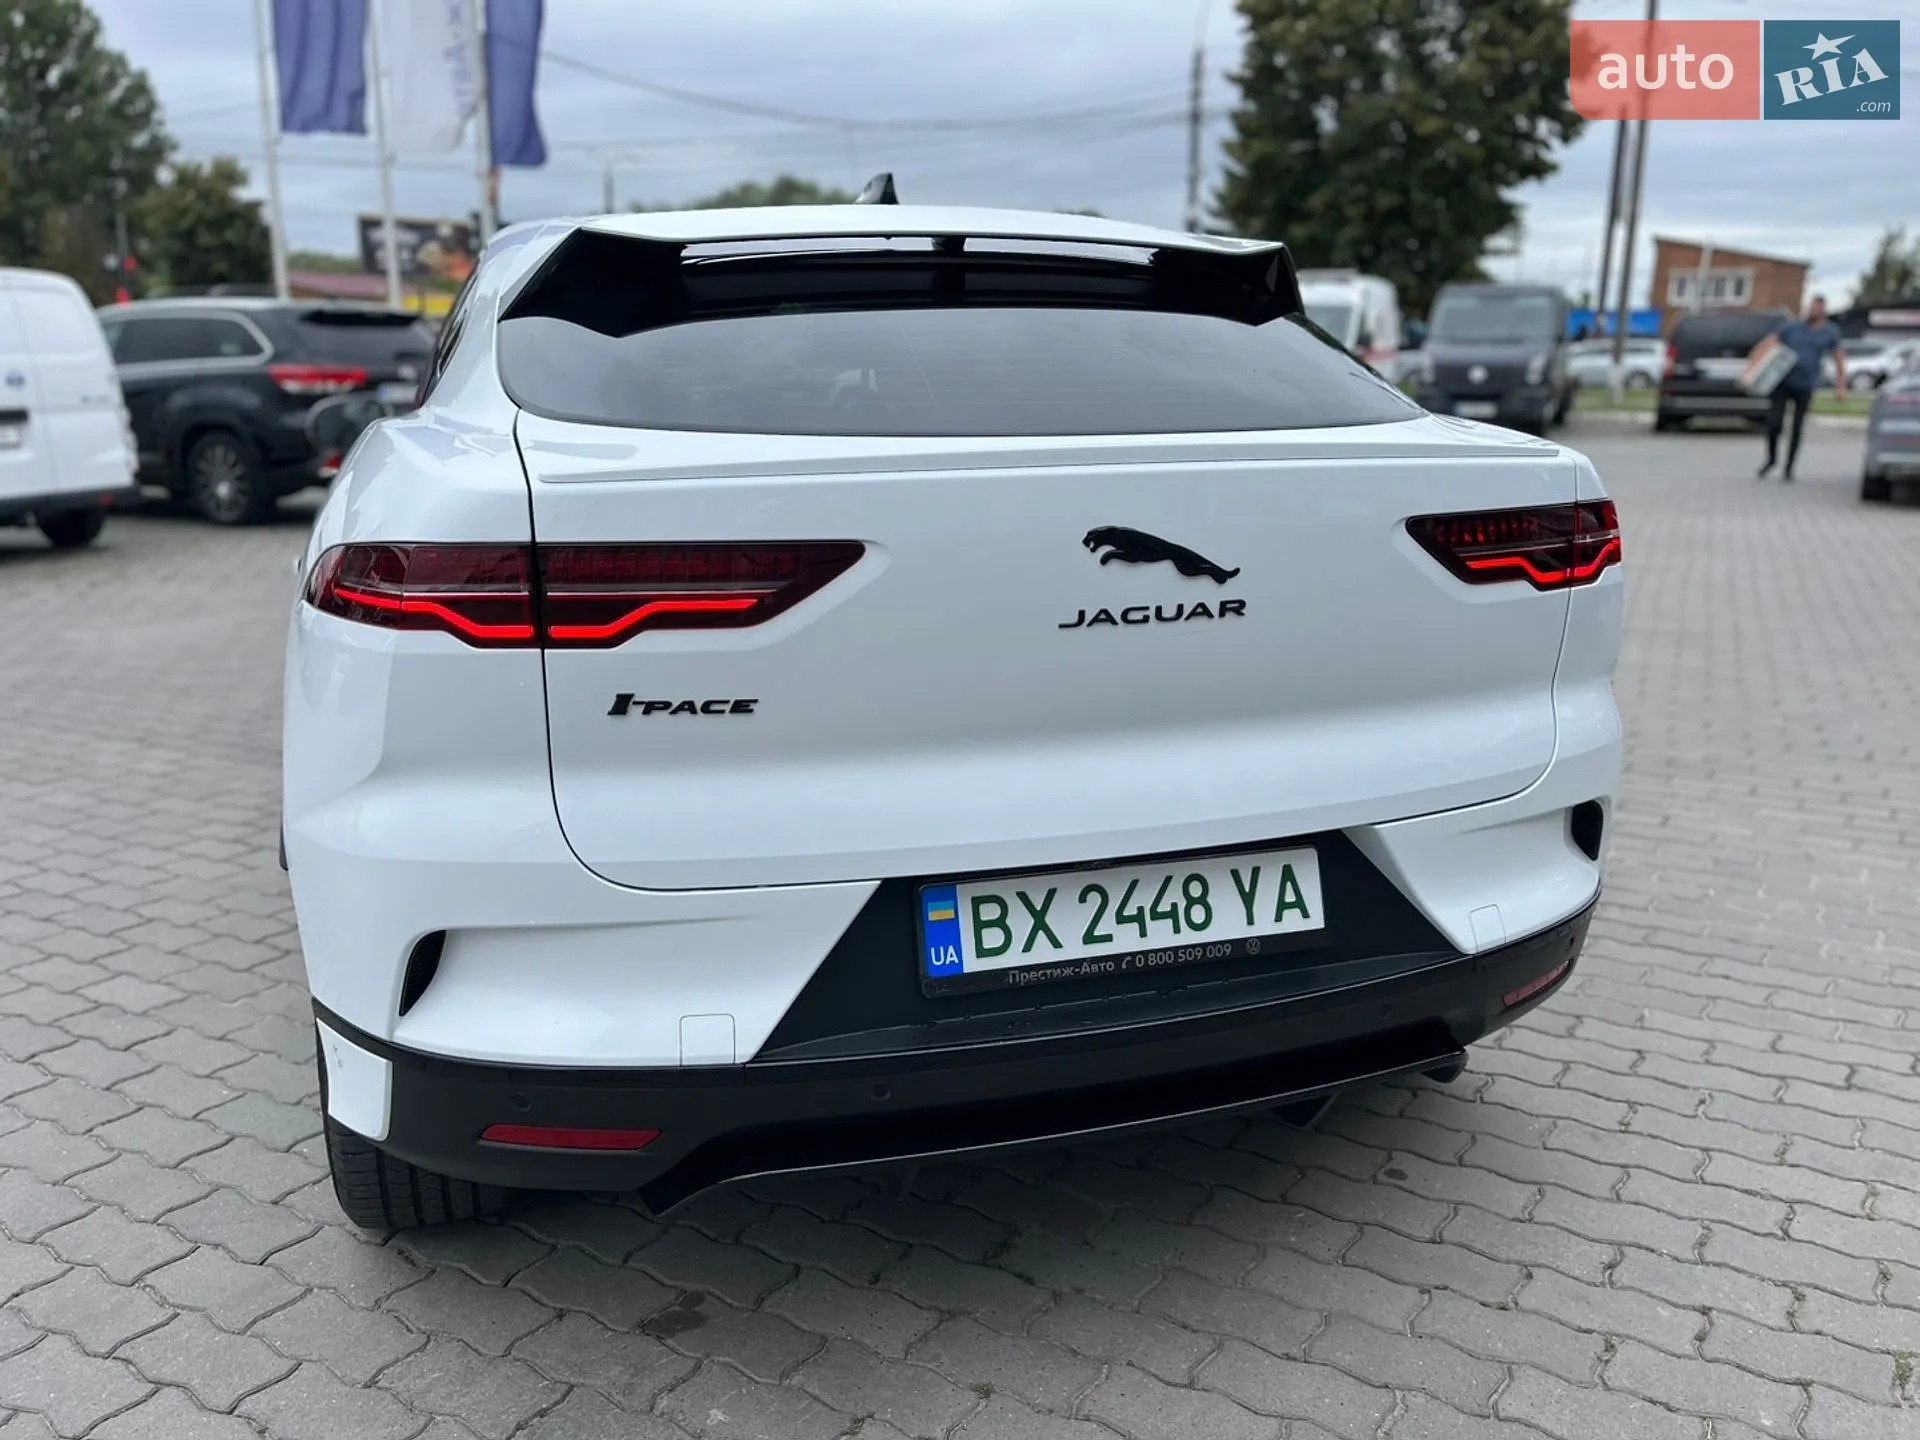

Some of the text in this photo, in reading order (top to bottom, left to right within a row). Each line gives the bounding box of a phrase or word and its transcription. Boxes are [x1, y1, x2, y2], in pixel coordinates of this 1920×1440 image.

[1058, 599, 1246, 629] JAGUAR
[970, 863, 1311, 959] BX 2448 YA
[931, 945, 959, 966] UA
[1135, 954, 1144, 968] 0
[1147, 951, 1176, 967] 800
[1178, 947, 1204, 963] 509
[1206, 943, 1232, 960] 009
